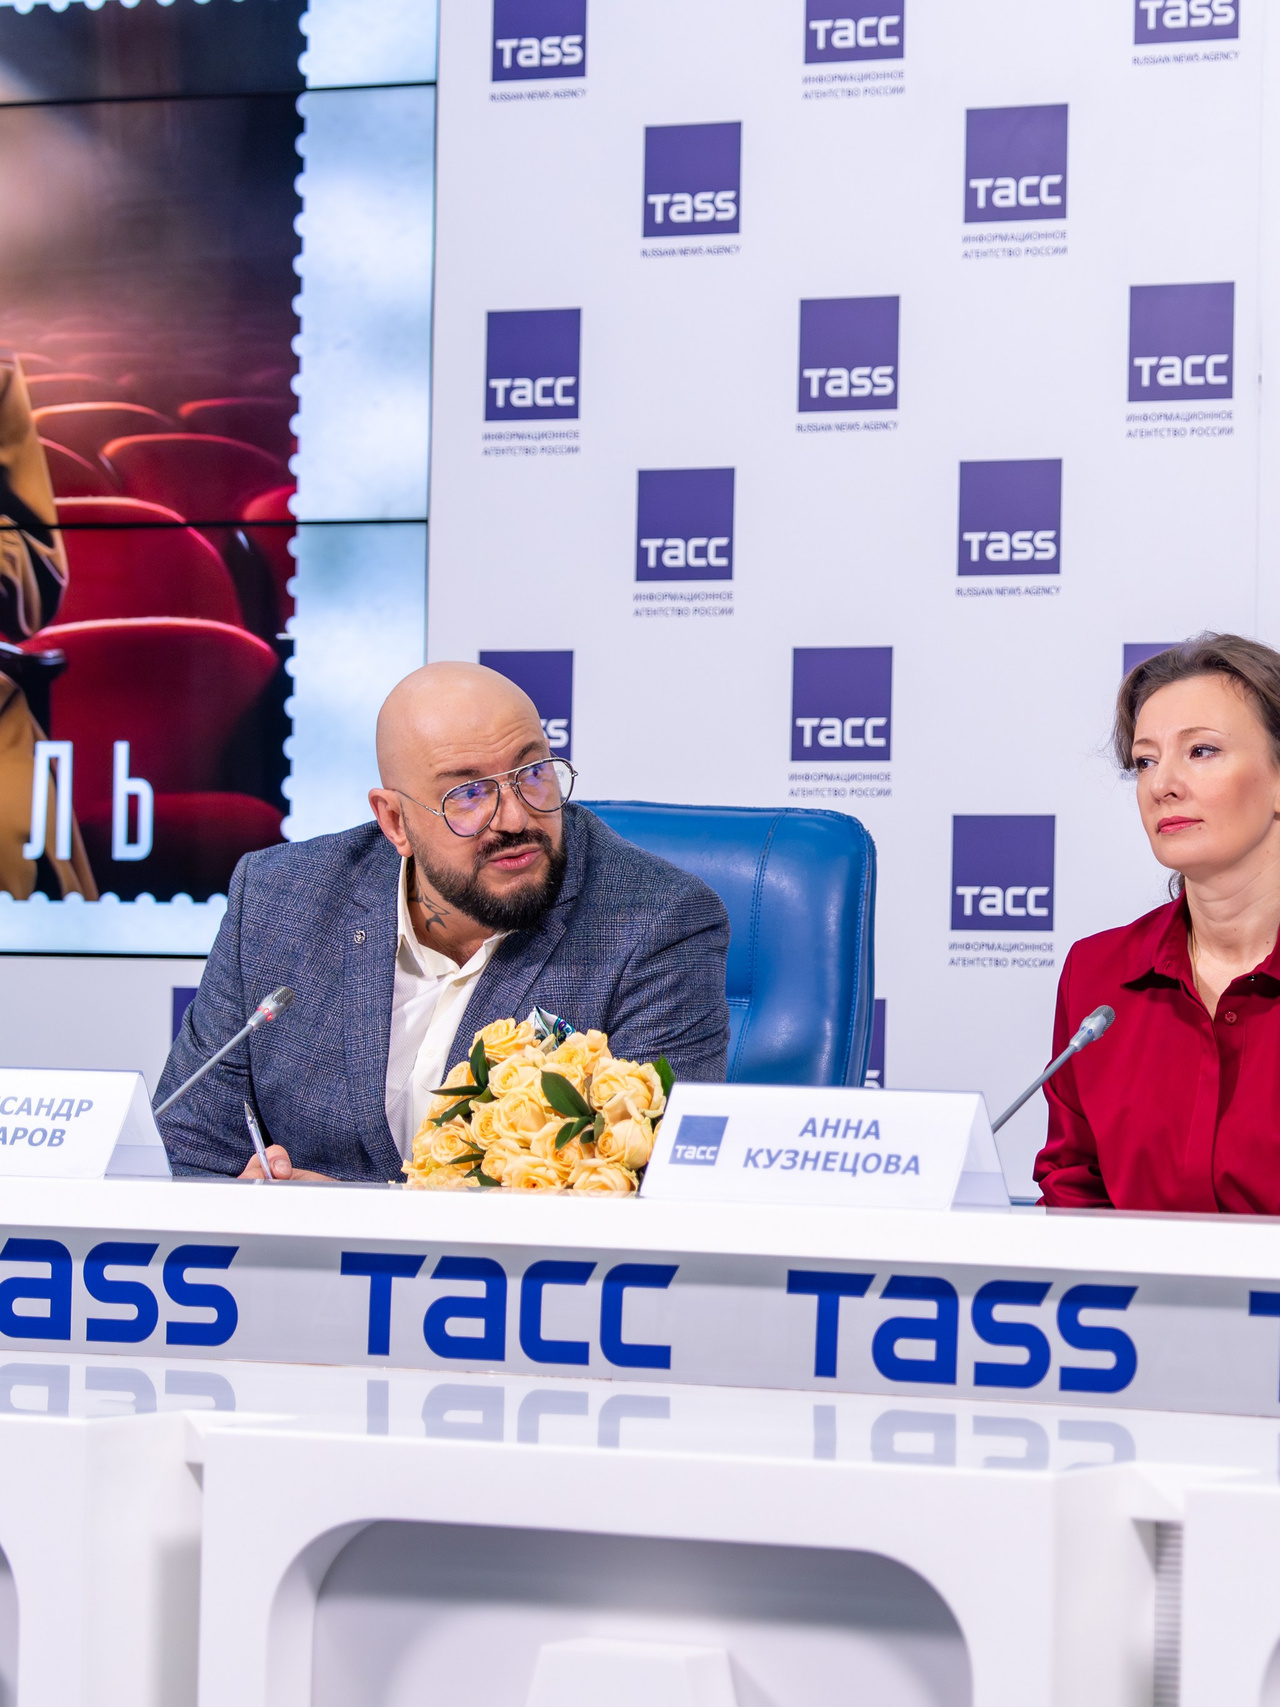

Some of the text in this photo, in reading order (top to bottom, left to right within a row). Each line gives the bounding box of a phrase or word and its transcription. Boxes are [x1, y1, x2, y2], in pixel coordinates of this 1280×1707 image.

[0, 1096, 93, 1121] САНДР
[798, 1116, 881, 1141] АННА
[742, 1147, 921, 1177] КУЗНЕЦОВА
[0, 1238, 240, 1347] ASS
